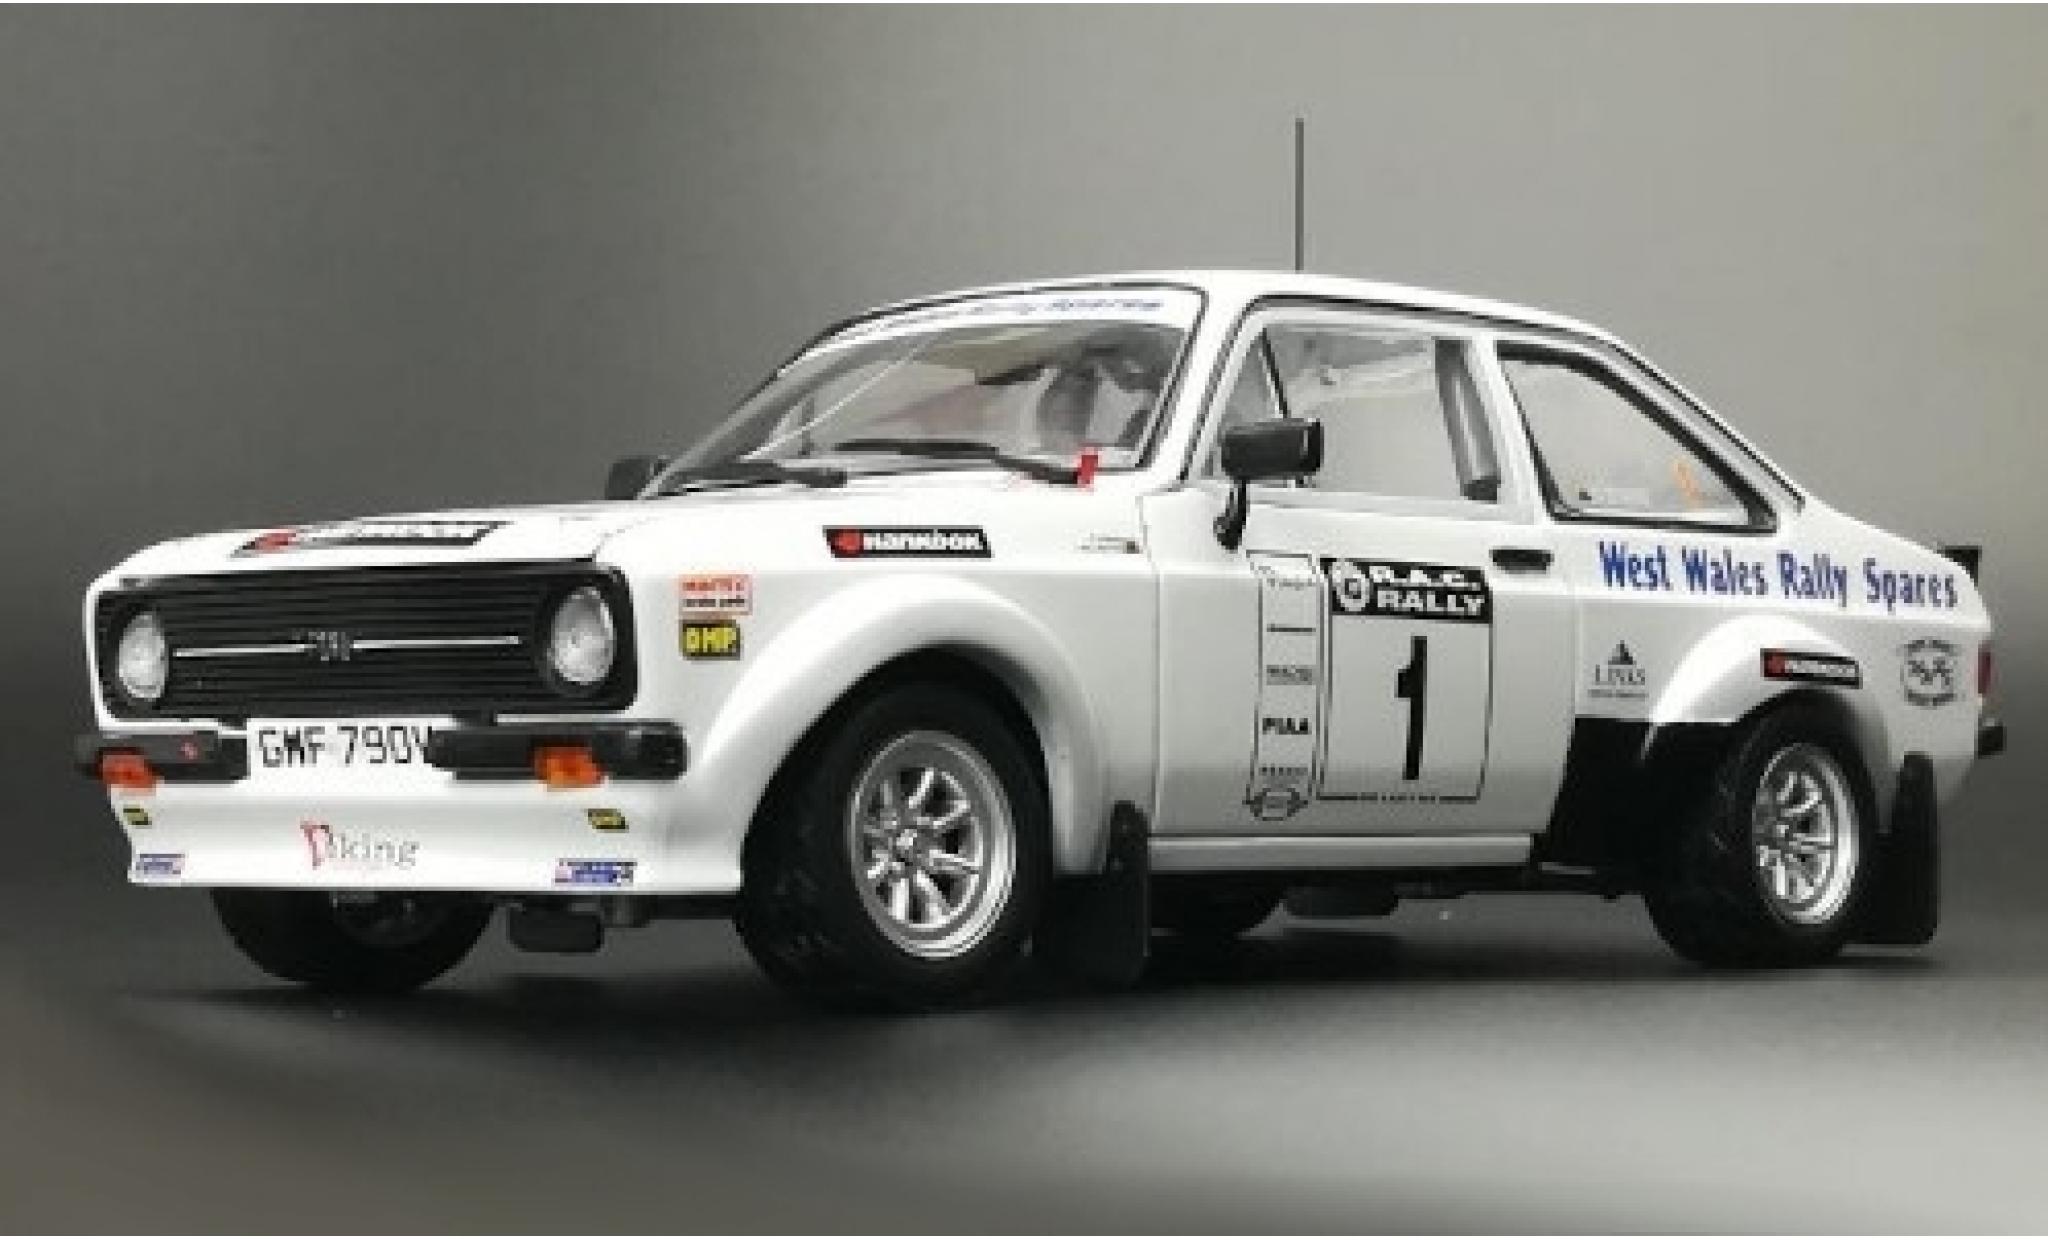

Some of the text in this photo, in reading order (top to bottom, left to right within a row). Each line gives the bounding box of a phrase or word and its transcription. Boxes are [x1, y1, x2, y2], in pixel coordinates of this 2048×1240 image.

[1597, 541, 1959, 611] West Wales Rally Spares
[1377, 589, 1485, 616] RALLY
[1262, 717, 1312, 736] PIAA
[1395, 635, 1428, 782] 1
